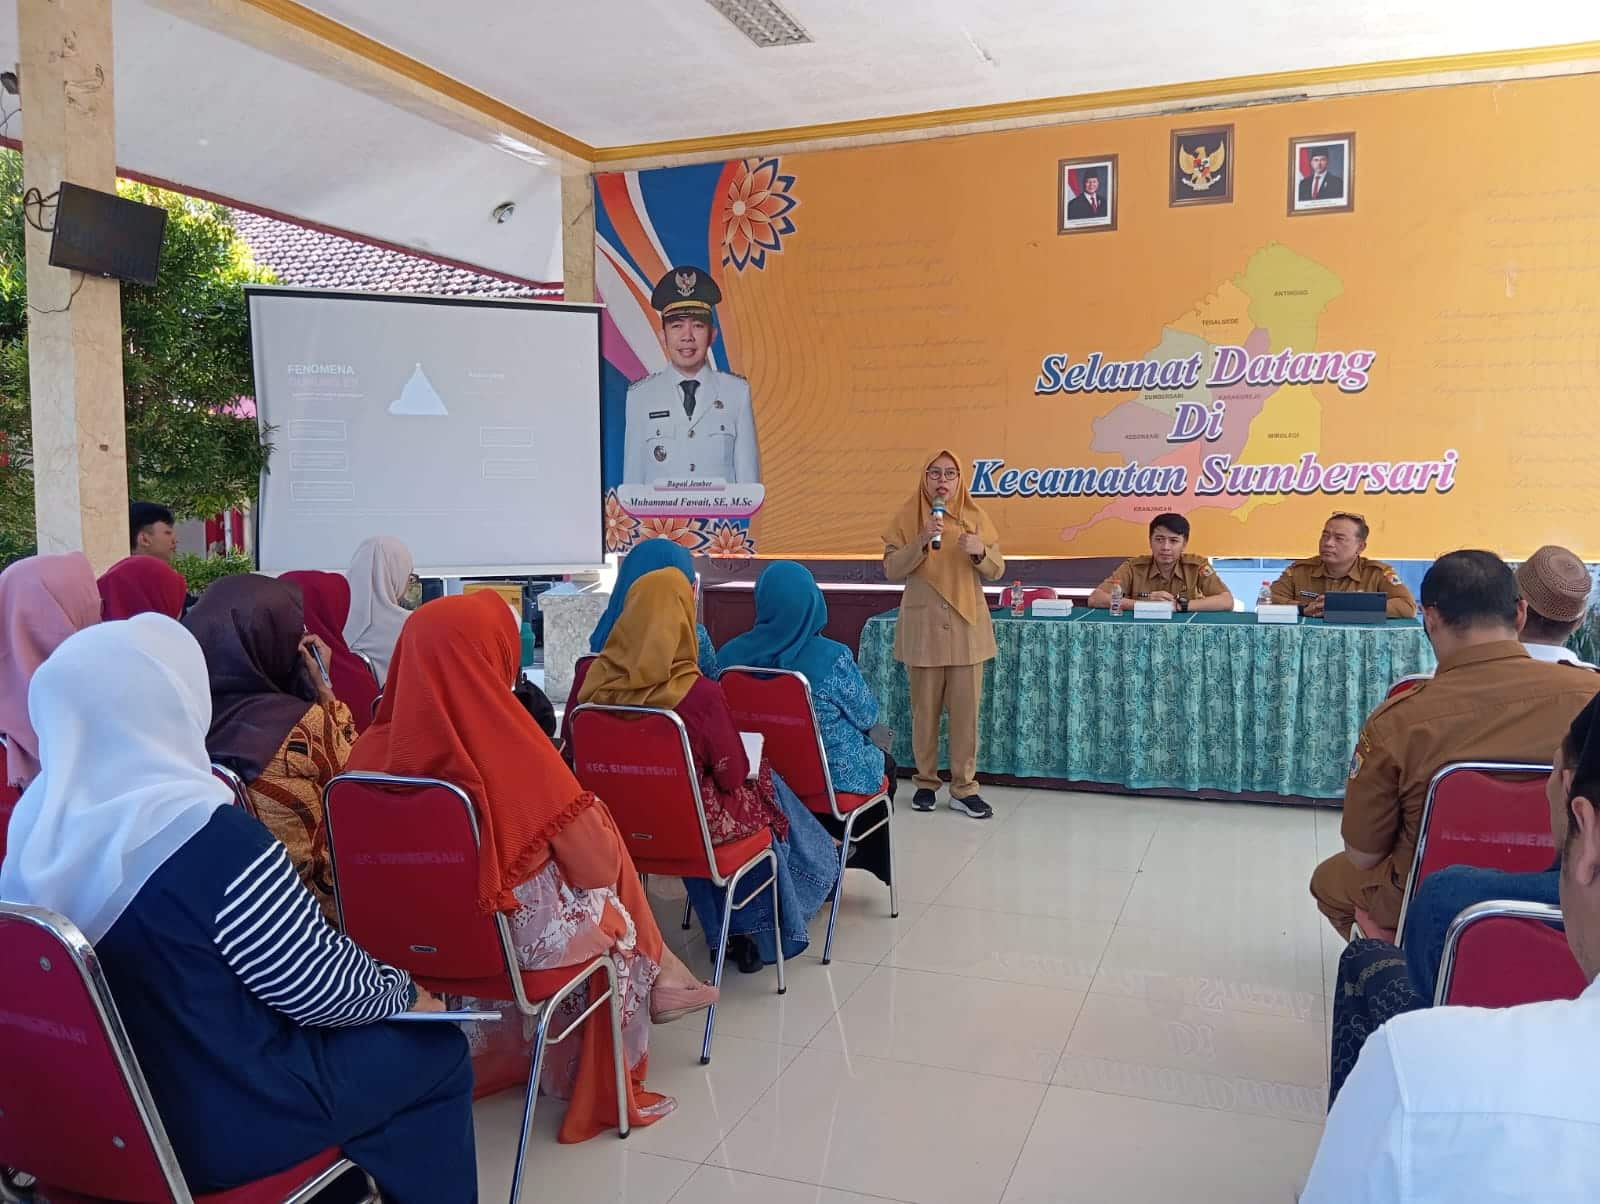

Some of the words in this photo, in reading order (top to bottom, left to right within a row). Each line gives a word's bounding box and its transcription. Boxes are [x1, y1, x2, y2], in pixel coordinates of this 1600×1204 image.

[287, 364, 354, 375] FENOMENA
[1035, 351, 1204, 394] Selamat
[1206, 345, 1376, 393] Datang
[1166, 400, 1226, 443] Di
[689, 480, 713, 488] Jember
[969, 459, 1187, 497] Kecamatan
[1194, 449, 1459, 496] Sumbersari
[630, 497, 679, 507] Muhammad
[680, 497, 711, 508] Fawait,
[730, 497, 753, 507] M.Sc
